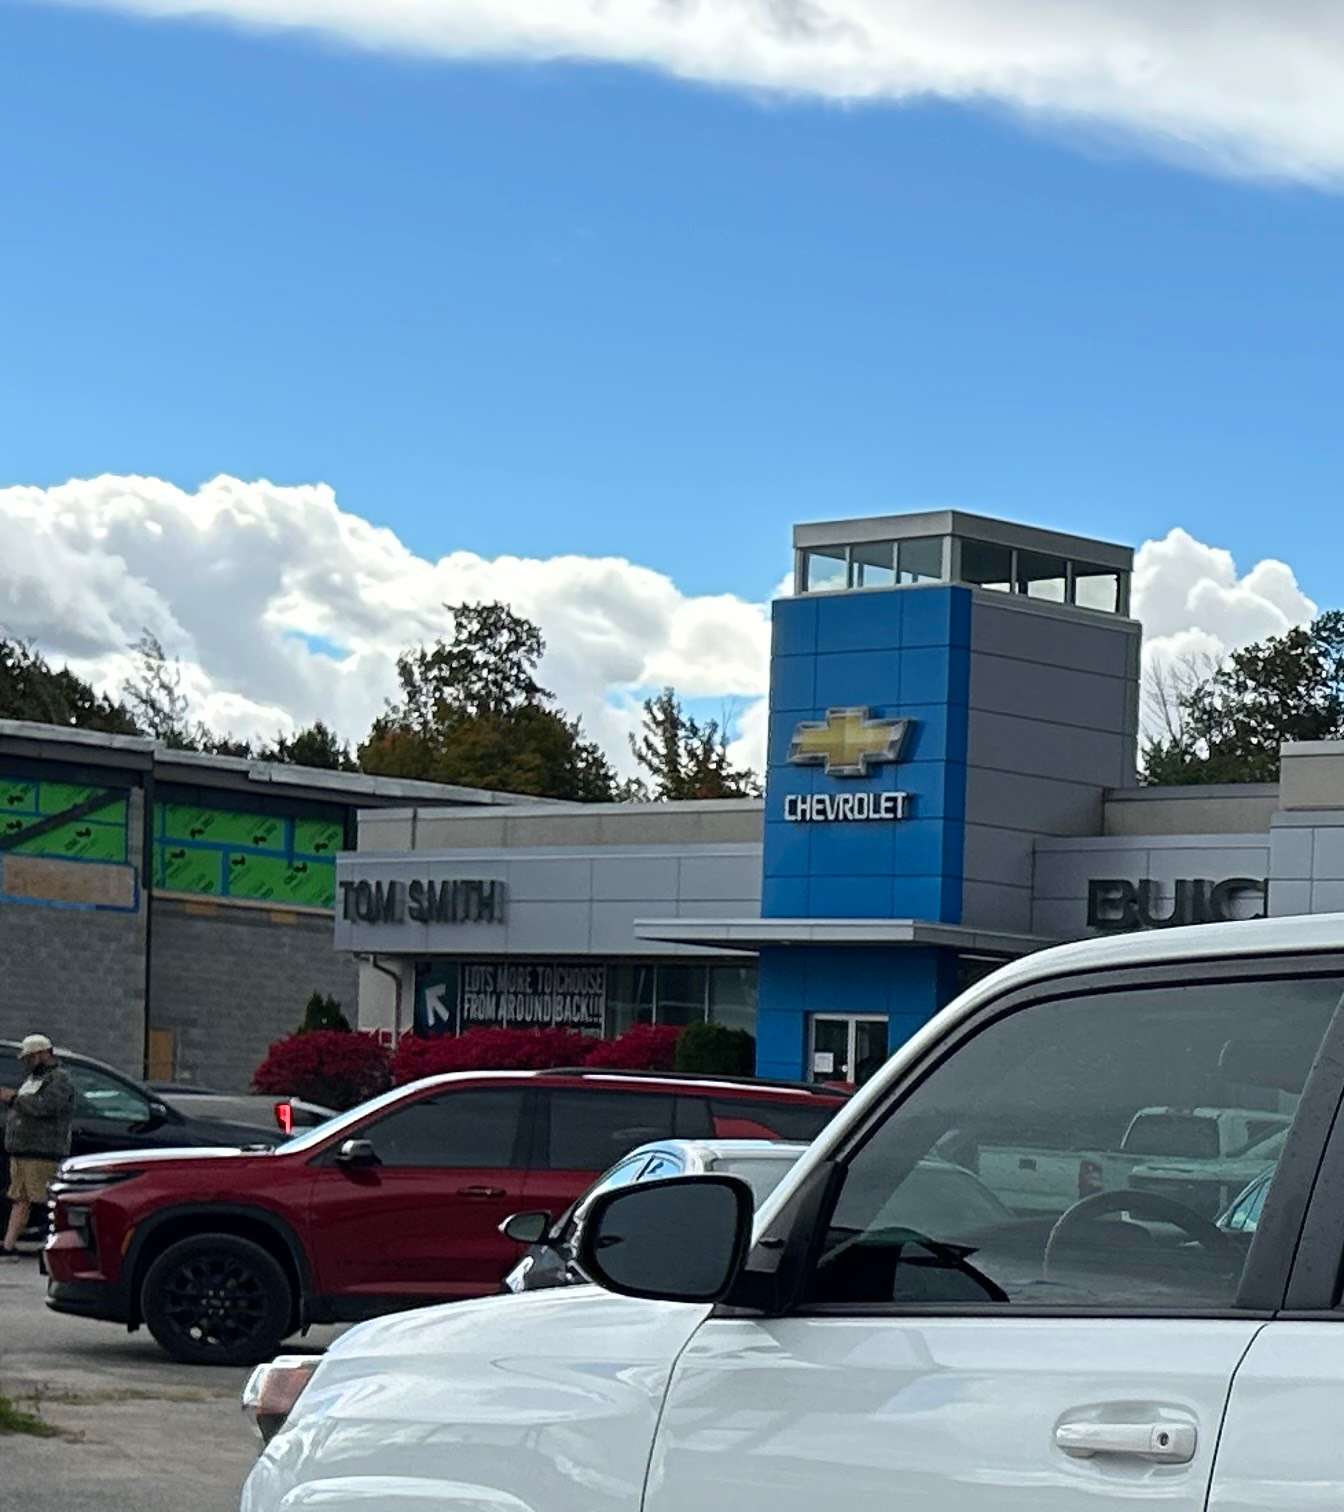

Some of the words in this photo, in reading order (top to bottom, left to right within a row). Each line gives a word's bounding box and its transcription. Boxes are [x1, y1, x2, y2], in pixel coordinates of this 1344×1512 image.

[784, 791, 907, 821] CHEVROLET
[340, 879, 404, 925] TOM
[408, 879, 508, 925] SMITH
[1087, 877, 1268, 928] BUIC
[464, 966, 495, 993] LOTS
[497, 966, 533, 993] MORE
[536, 967, 553, 993] TO
[556, 967, 603, 993] CHOOSE
[463, 994, 496, 1020] FROM
[498, 994, 552, 1022] AROUND
